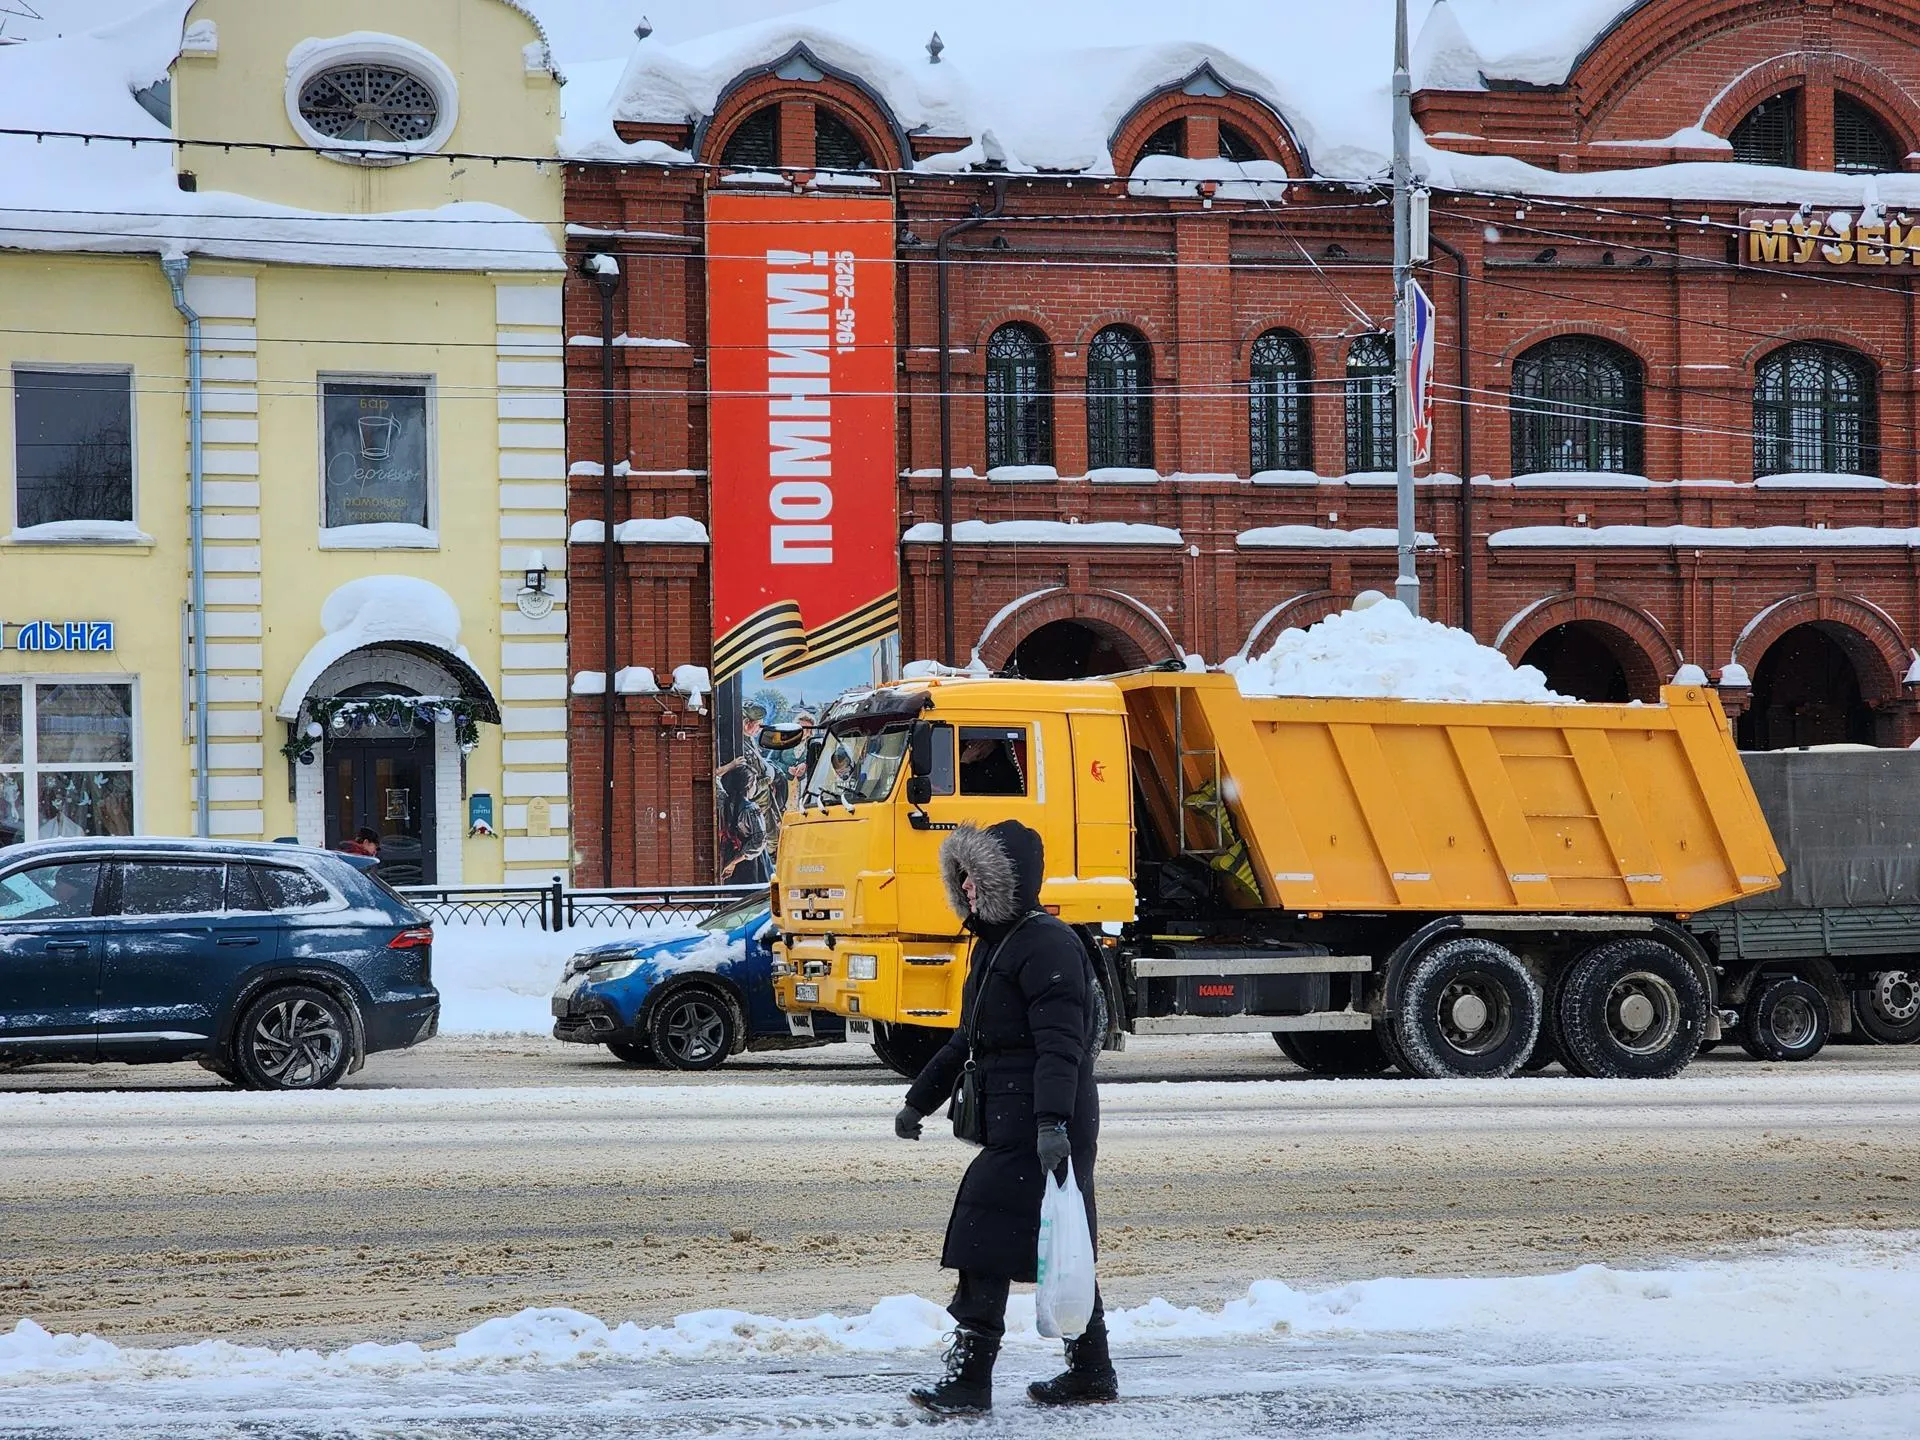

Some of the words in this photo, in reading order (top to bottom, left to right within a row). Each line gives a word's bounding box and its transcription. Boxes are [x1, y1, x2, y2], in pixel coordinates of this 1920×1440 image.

[1749, 213, 1920, 266] МУЗЕЙ
[766, 249, 833, 564] ПОМНИМ!
[1199, 985, 1235, 996] KAMAZ
